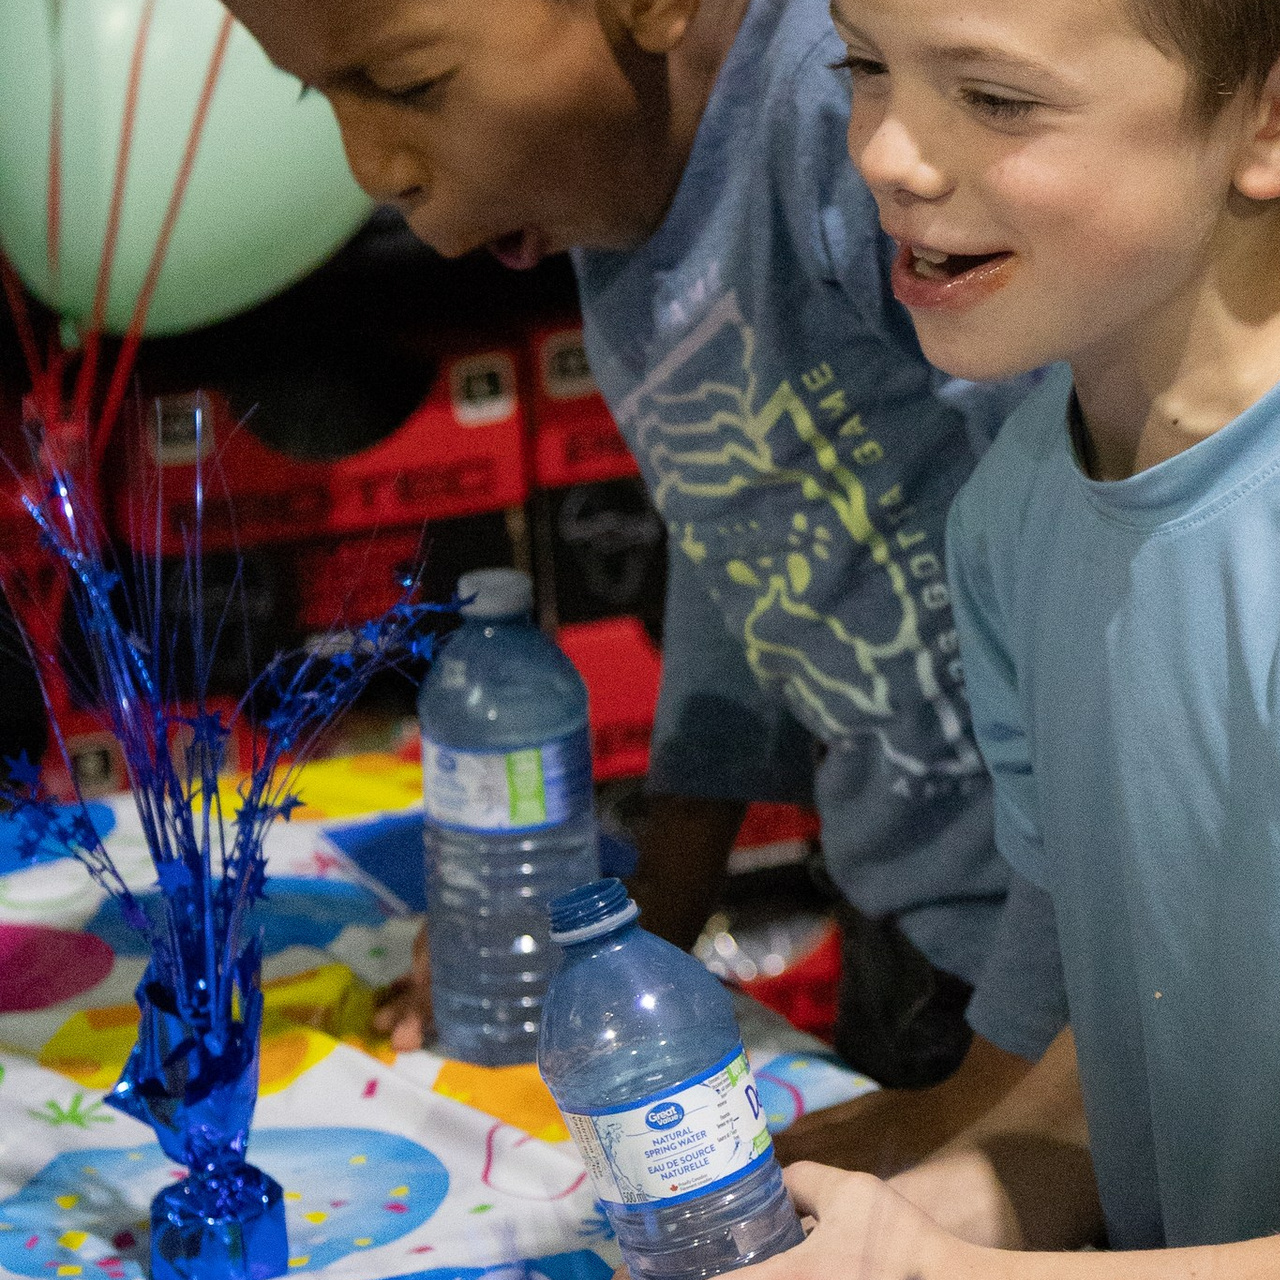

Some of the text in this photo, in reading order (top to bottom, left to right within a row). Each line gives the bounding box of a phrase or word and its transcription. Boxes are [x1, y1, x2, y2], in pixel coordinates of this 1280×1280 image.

[648, 1106, 678, 1122] Great
[657, 1114, 679, 1126] Value
[644, 1130, 707, 1159] SPRING WATER
[652, 1126, 693, 1147] NATURAL
[647, 1144, 716, 1175] EAU DE SOURCE
[660, 1157, 710, 1181] NATURELLE
